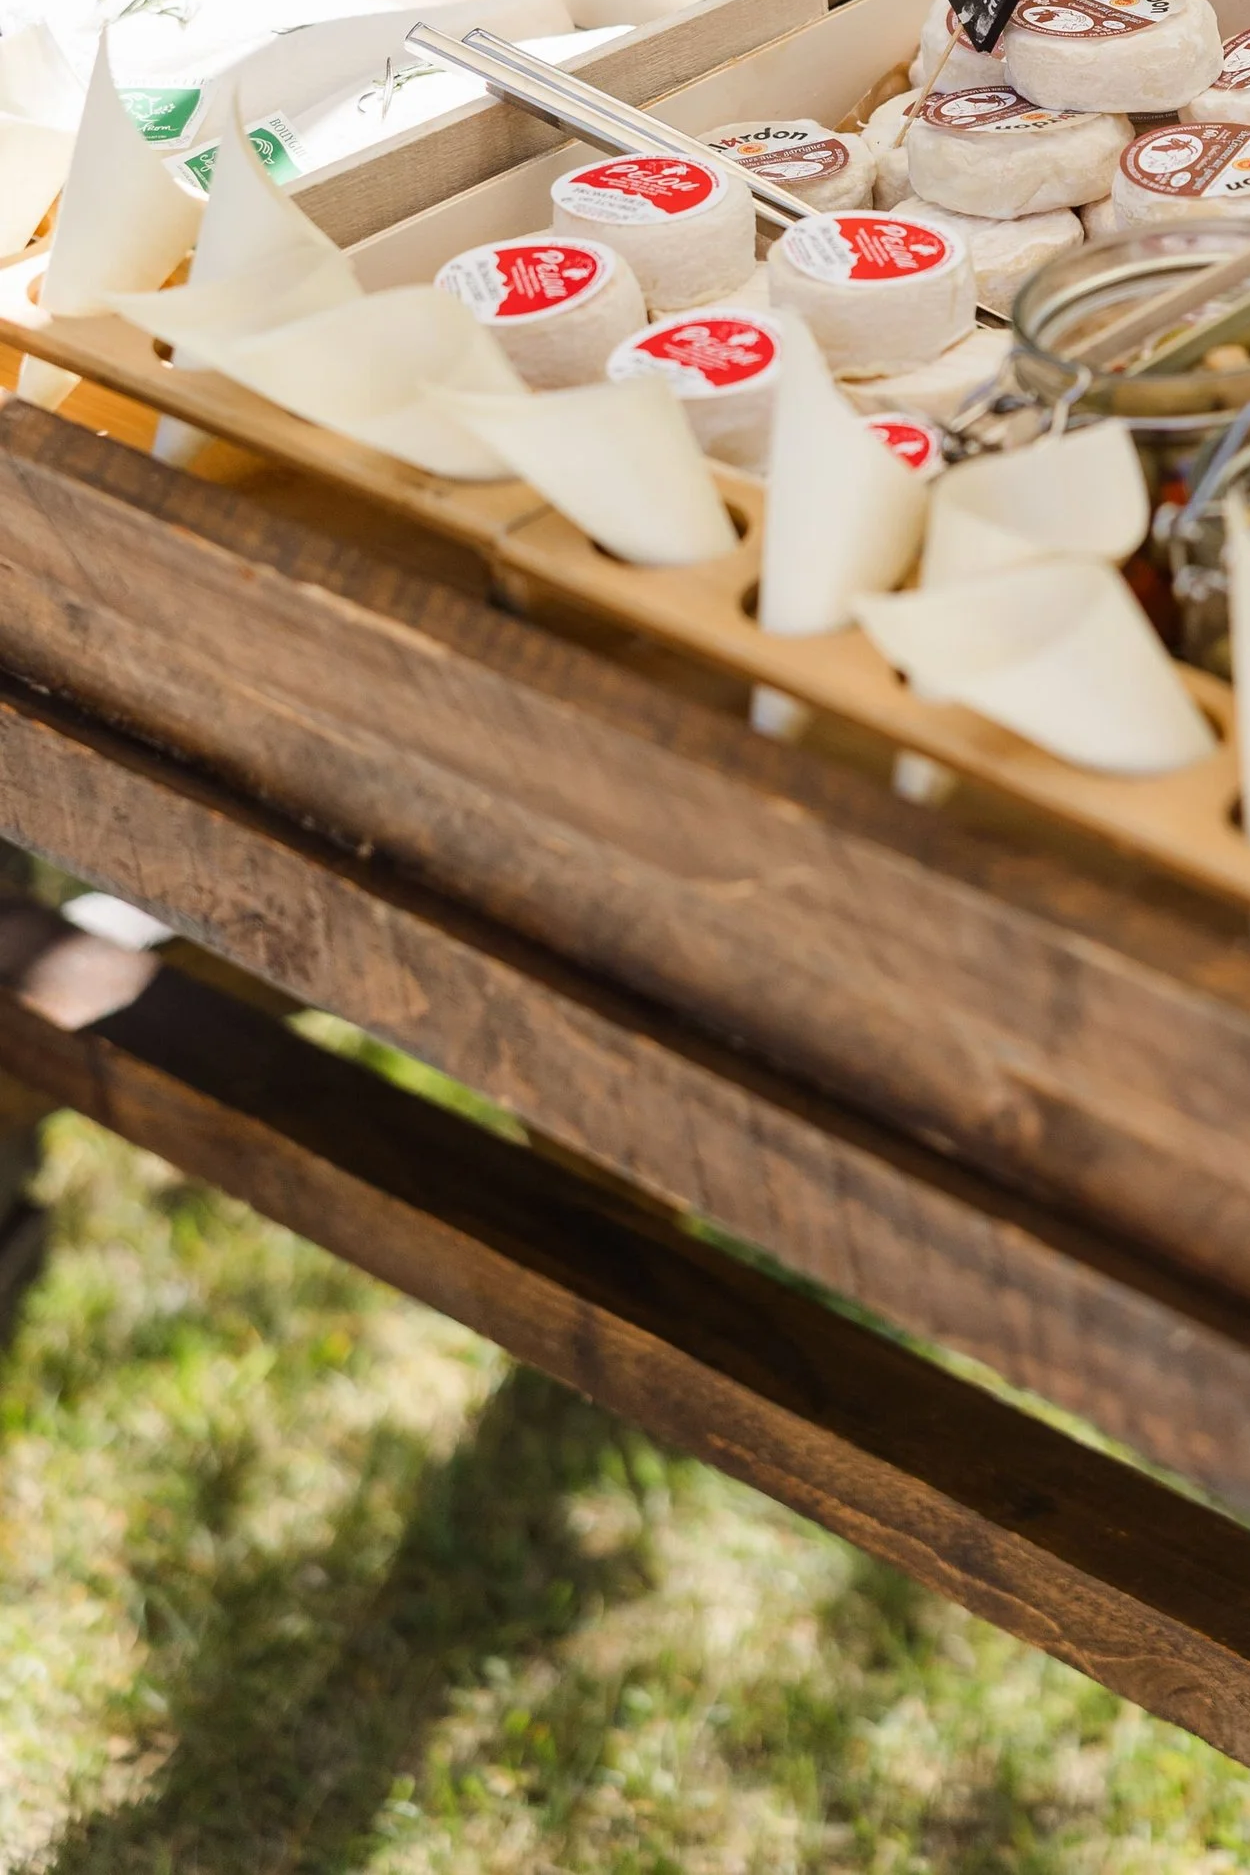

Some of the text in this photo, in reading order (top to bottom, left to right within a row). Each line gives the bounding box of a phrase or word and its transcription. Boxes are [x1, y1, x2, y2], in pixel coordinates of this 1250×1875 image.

[995, 109, 1085, 131] lardon
[708, 127, 808, 150] lardon
[784, 143, 826, 157] garrigues
